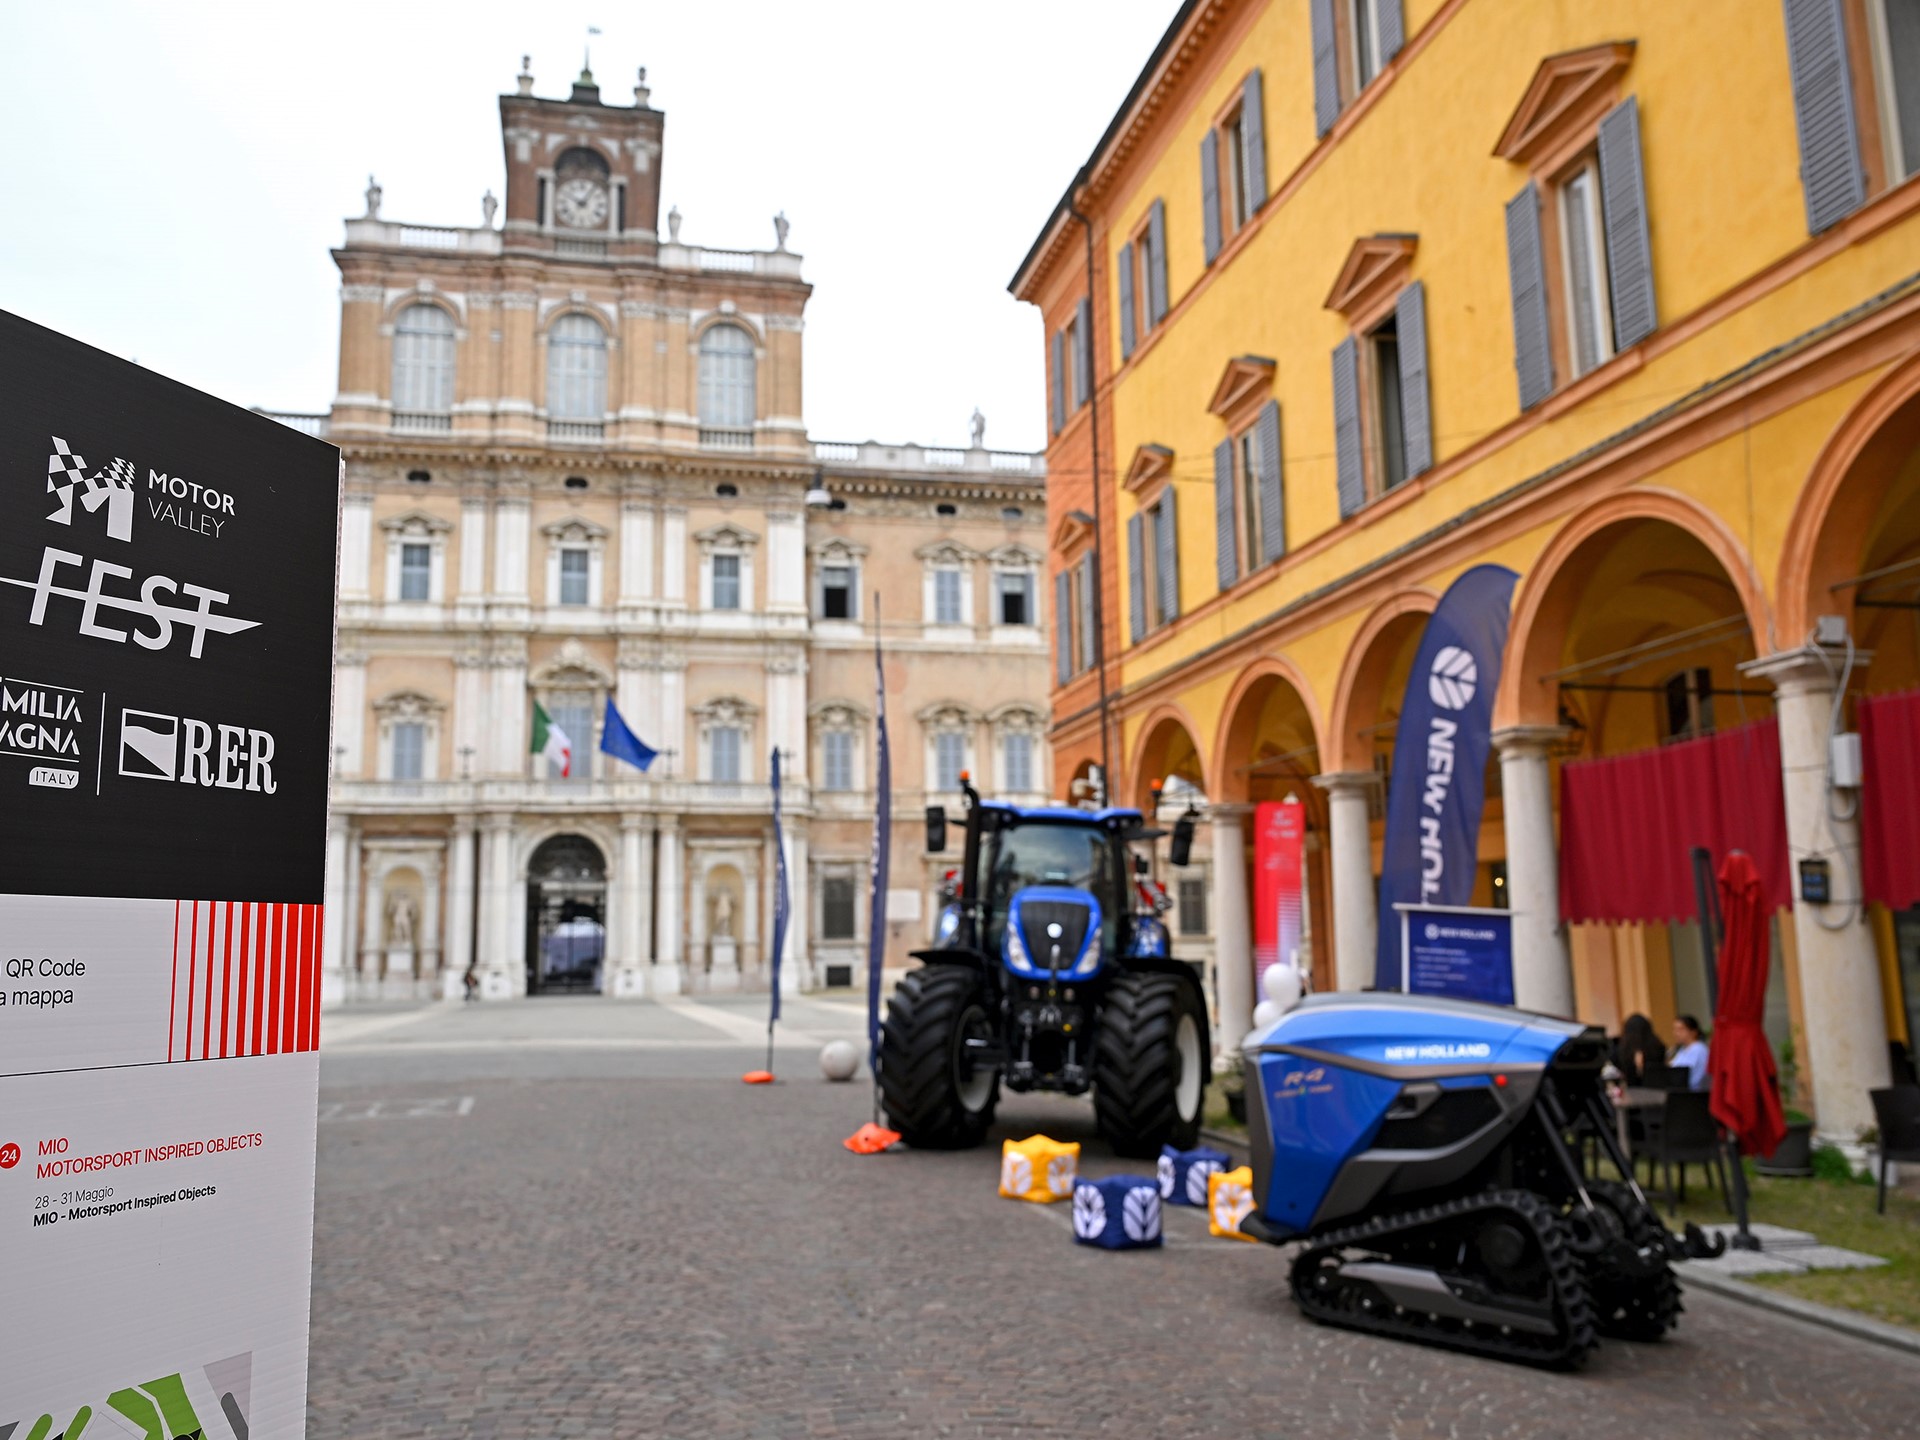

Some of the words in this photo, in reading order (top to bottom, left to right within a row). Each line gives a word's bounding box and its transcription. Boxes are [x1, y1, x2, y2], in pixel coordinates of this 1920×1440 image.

[148, 468, 236, 517] MOTOR
[147, 496, 225, 539] VALLEY
[29, 546, 230, 660] FEST
[35, 770, 76, 786] ITALY
[1422, 716, 1458, 816] NEW
[1420, 815, 1444, 906] HOL
[6, 958, 34, 979] QR
[38, 958, 86, 977] Code
[12, 989, 74, 1009] mappa
[1385, 1045, 1418, 1061] NEW
[1419, 1042, 1491, 1059] HOLLAND
[1, 1148, 17, 1163] 24
[36, 1149, 142, 1179] MOTORSPORT
[144, 1141, 204, 1163] INSPIRED
[206, 1132, 263, 1154] OBJECTS
[38, 1137, 69, 1156] MIO
[33, 1211, 59, 1227] MIO
[68, 1198, 133, 1221] Motorsport
[134, 1190, 177, 1209] Inspired
[178, 1184, 217, 1201] Objects
[34, 1195, 50, 1210] 28
[60, 1191, 73, 1205] 31
[75, 1185, 115, 1203] Maggio
